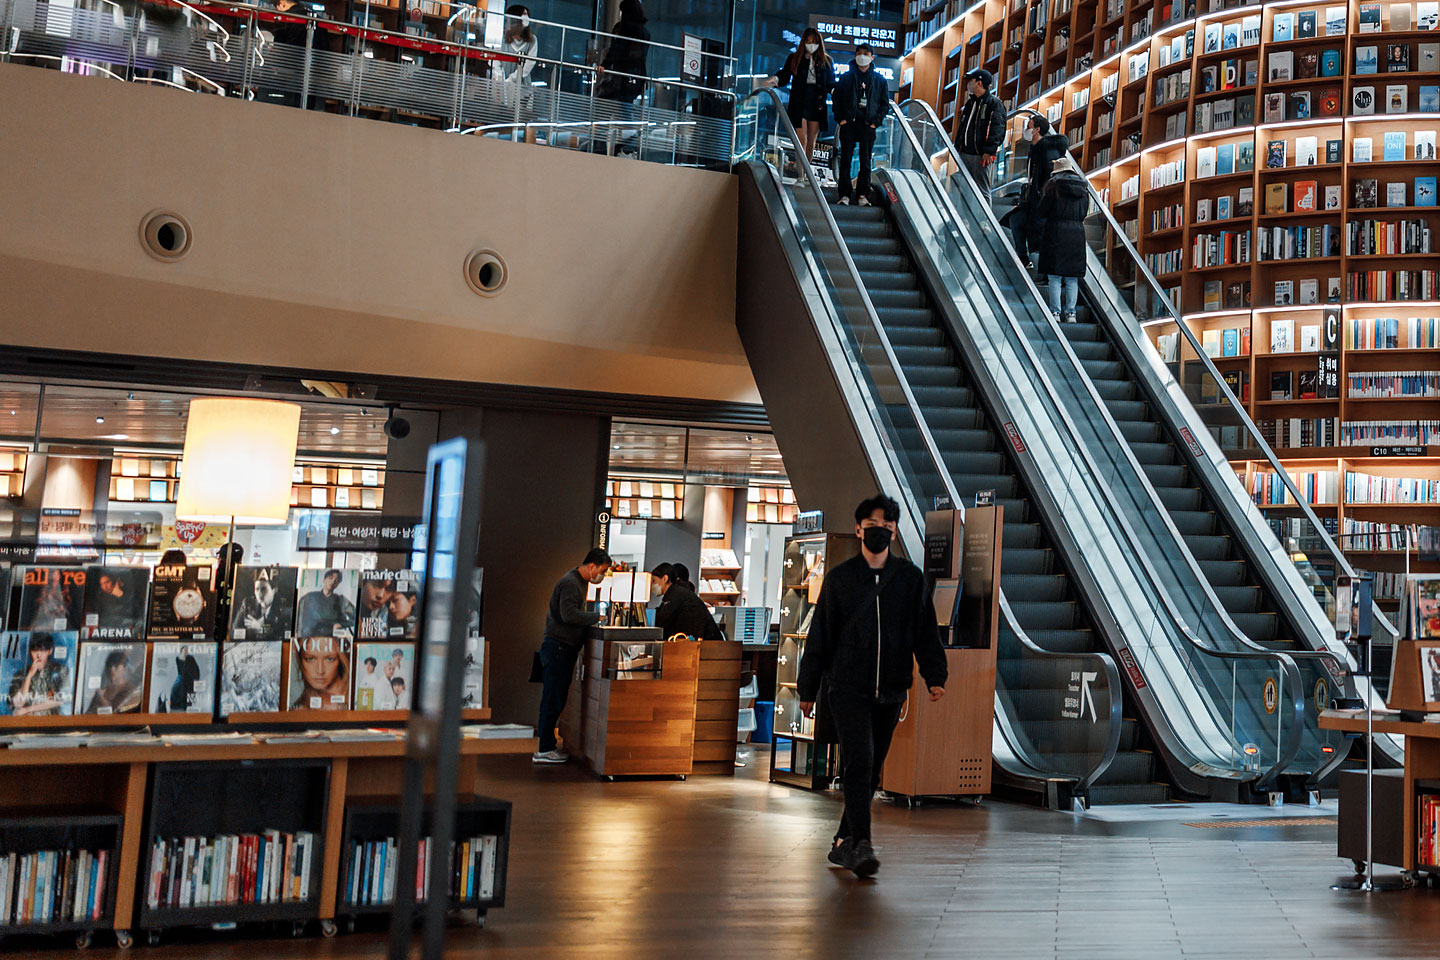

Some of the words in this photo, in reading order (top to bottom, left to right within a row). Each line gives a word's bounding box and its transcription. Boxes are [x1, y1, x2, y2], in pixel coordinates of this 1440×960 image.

[817, 22, 842, 35] 토이셔
[871, 28, 896, 40] 라운지
[1327, 314, 1336, 343] C
[25, 568, 86, 586] allre
[155, 566, 186, 576] GMT
[363, 569, 394, 580] marie
[92, 628, 132, 638] ARENA
[292, 638, 351, 653] VOGUE
